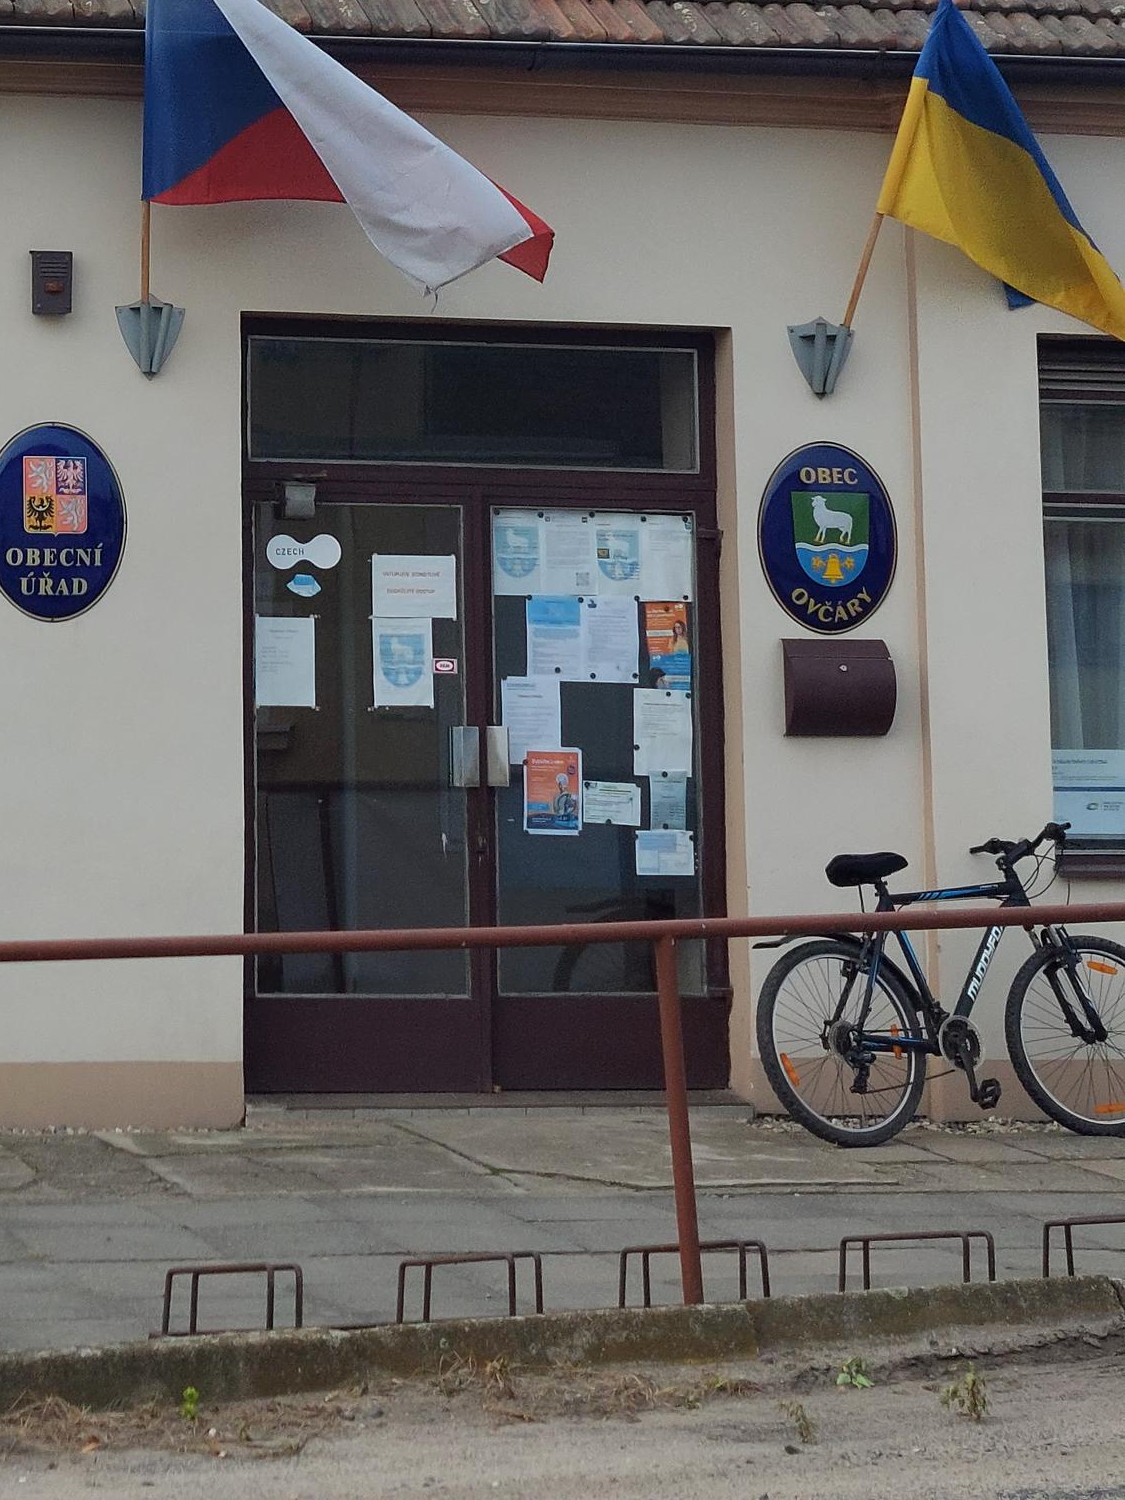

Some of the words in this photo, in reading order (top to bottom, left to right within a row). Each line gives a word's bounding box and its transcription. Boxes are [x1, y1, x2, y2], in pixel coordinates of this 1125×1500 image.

[799, 466, 859, 485] OBEC
[5, 542, 104, 567] OBECNÍ
[275, 547, 305, 556] CZECH
[19, 571, 88, 596] ÚŘAD
[791, 586, 873, 622] OVČÁRY
[967, 925, 1003, 1002] MUDDYFO
